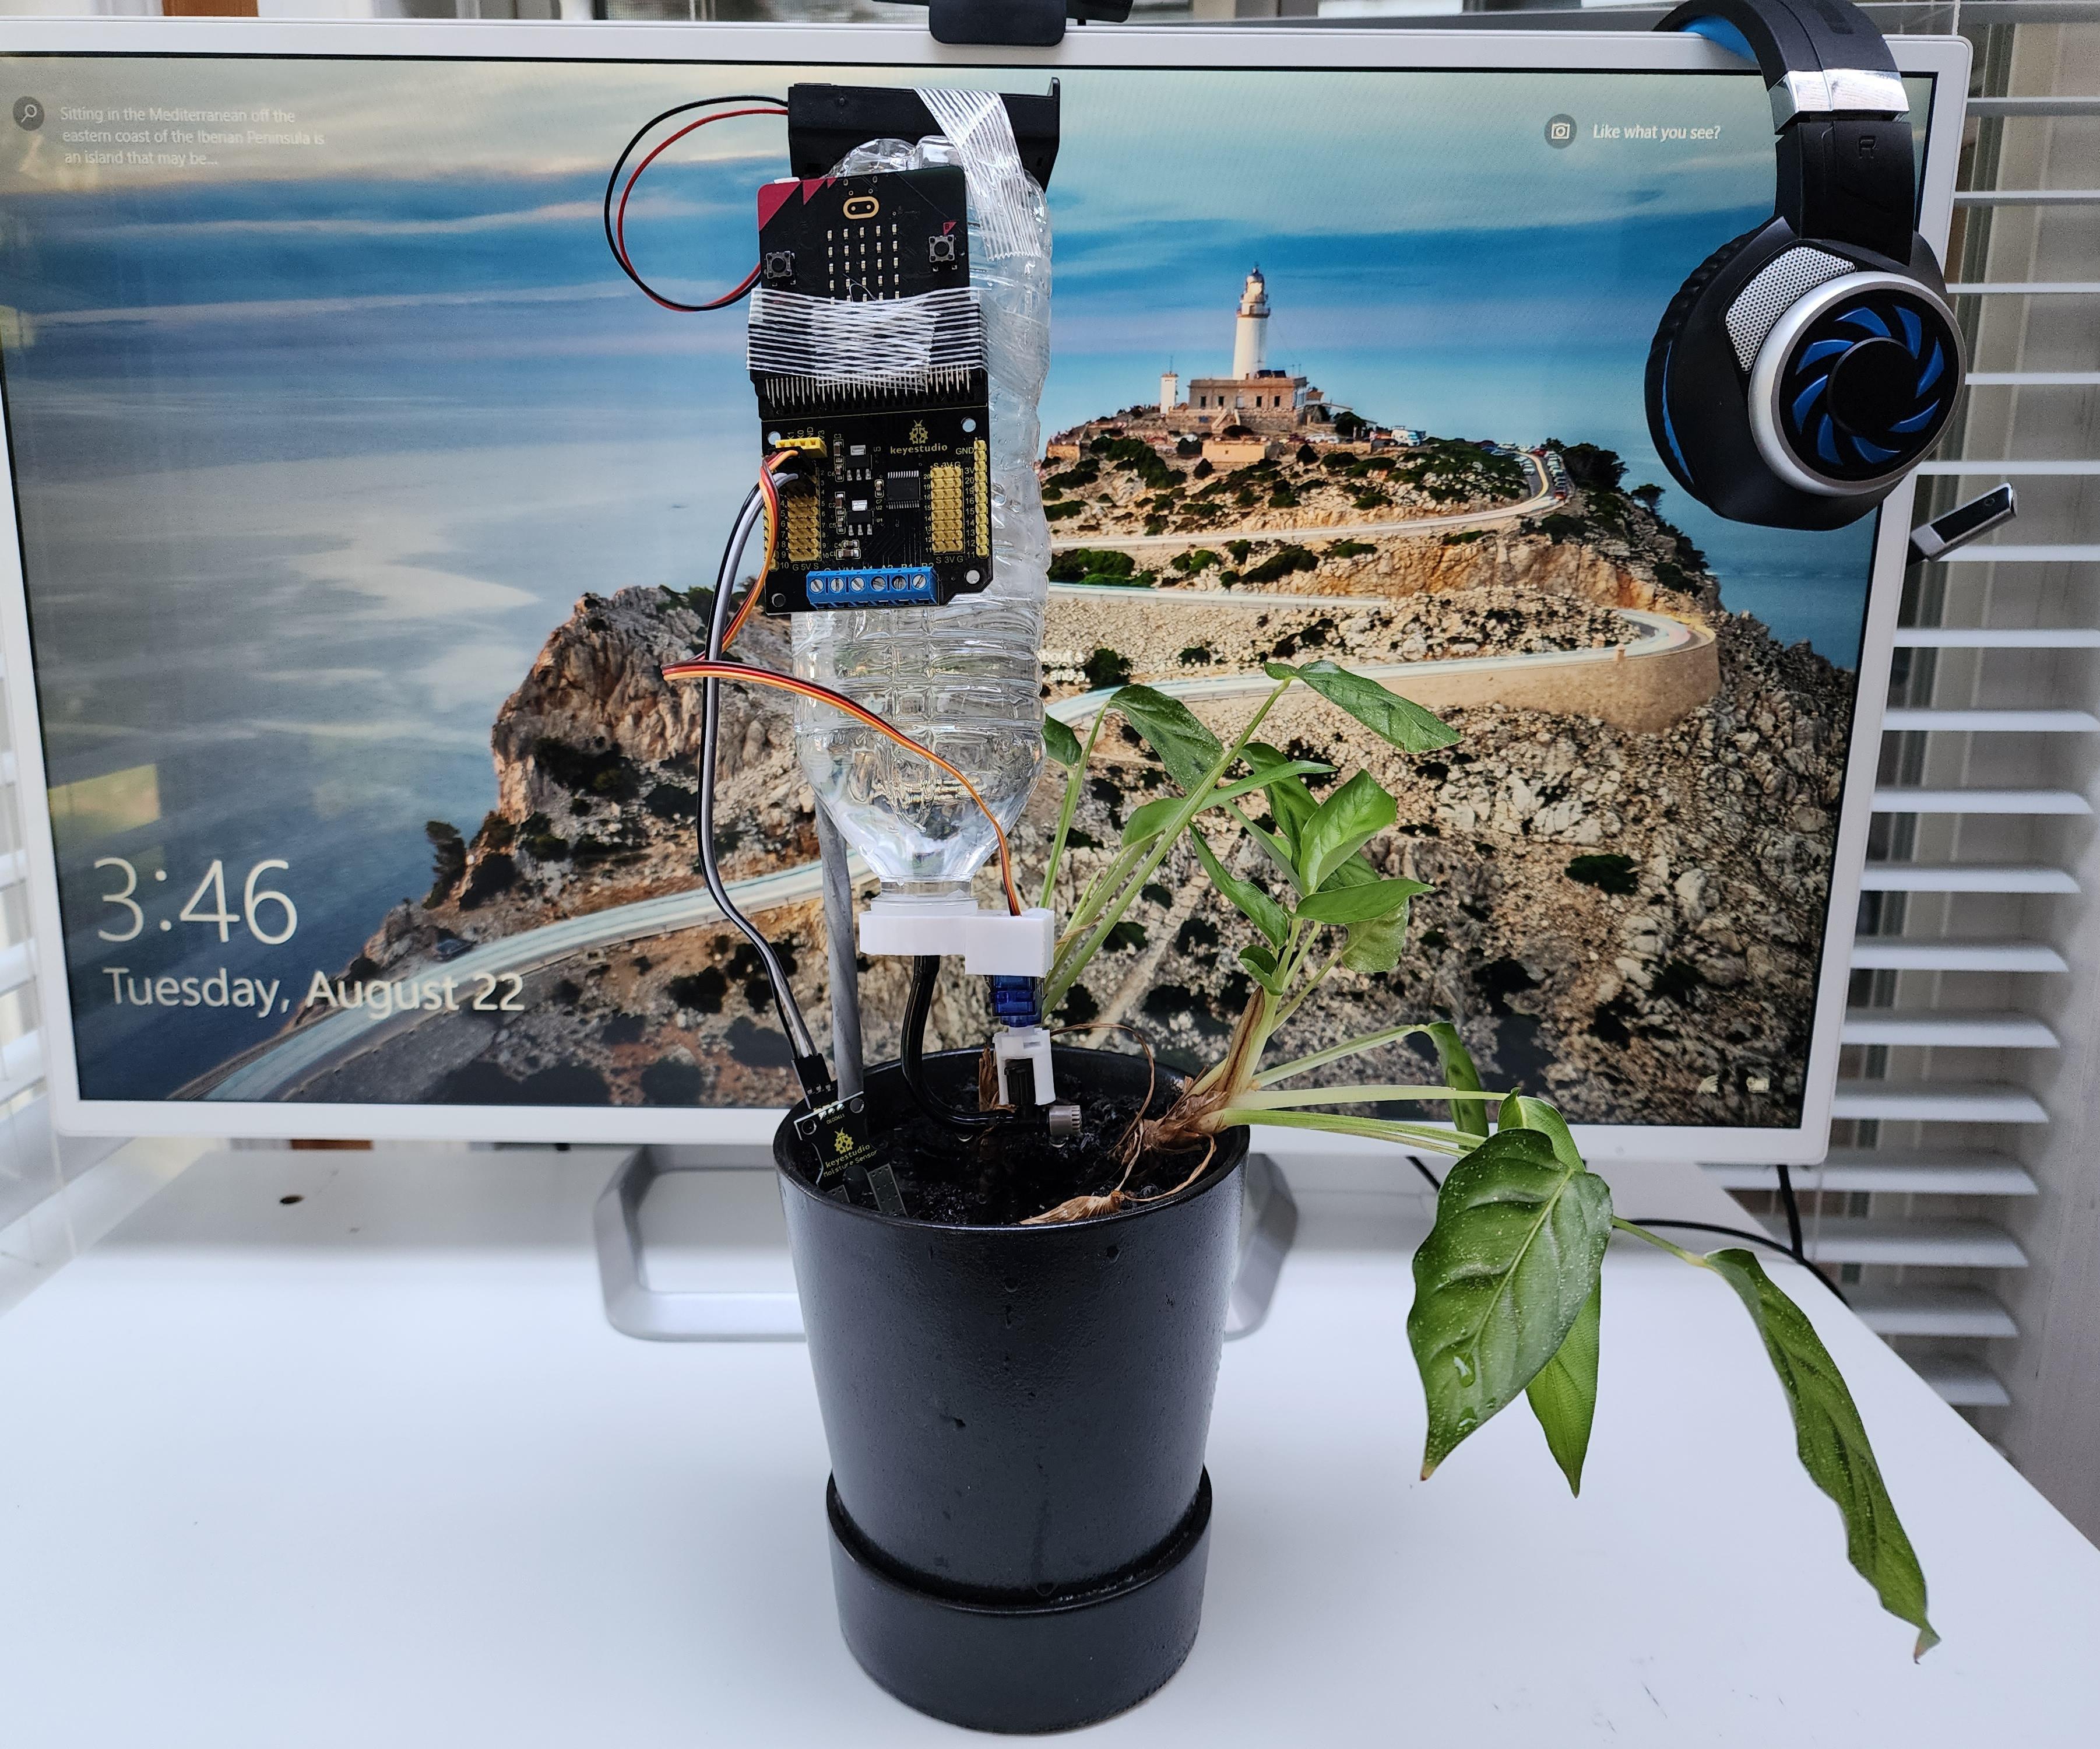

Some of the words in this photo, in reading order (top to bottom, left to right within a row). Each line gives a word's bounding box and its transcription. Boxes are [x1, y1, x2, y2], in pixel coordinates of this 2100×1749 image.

[60, 107, 103, 124] Sitting
[107, 107, 119, 121] in
[123, 107, 146, 121] the
[150, 107, 247, 122] Mediterranean
[251, 108, 271, 122] off
[272, 109, 296, 122] the
[62, 130, 111, 143] eastern
[115, 130, 151, 143] coast
[154, 129, 169, 143] of
[173, 129, 194, 143] the
[197, 130, 243, 144] Iberian
[247, 131, 311, 145] Peninsula
[314, 133, 325, 145] is
[1593, 124, 1620, 139] Like
[1624, 125, 1658, 139] what
[1659, 127, 1687, 142] you
[1690, 125, 1721, 139] see?
[1858, 135, 1877, 159] R
[65, 153, 80, 164] an
[85, 150, 122, 164] island
[126, 150, 154, 164] that
[159, 153, 185, 167] may
[890, 443, 948, 455] keyestudio
[94, 857, 298, 944] 3:46
[103, 967, 289, 1019] Tuesday,
[305, 970, 459, 1020] August
[472, 972, 526, 1012] 22
[823, 1160, 854, 1178] Moisture
[854, 1150, 877, 1164] Sensor
[825, 1144, 870, 1168] keyestudio
